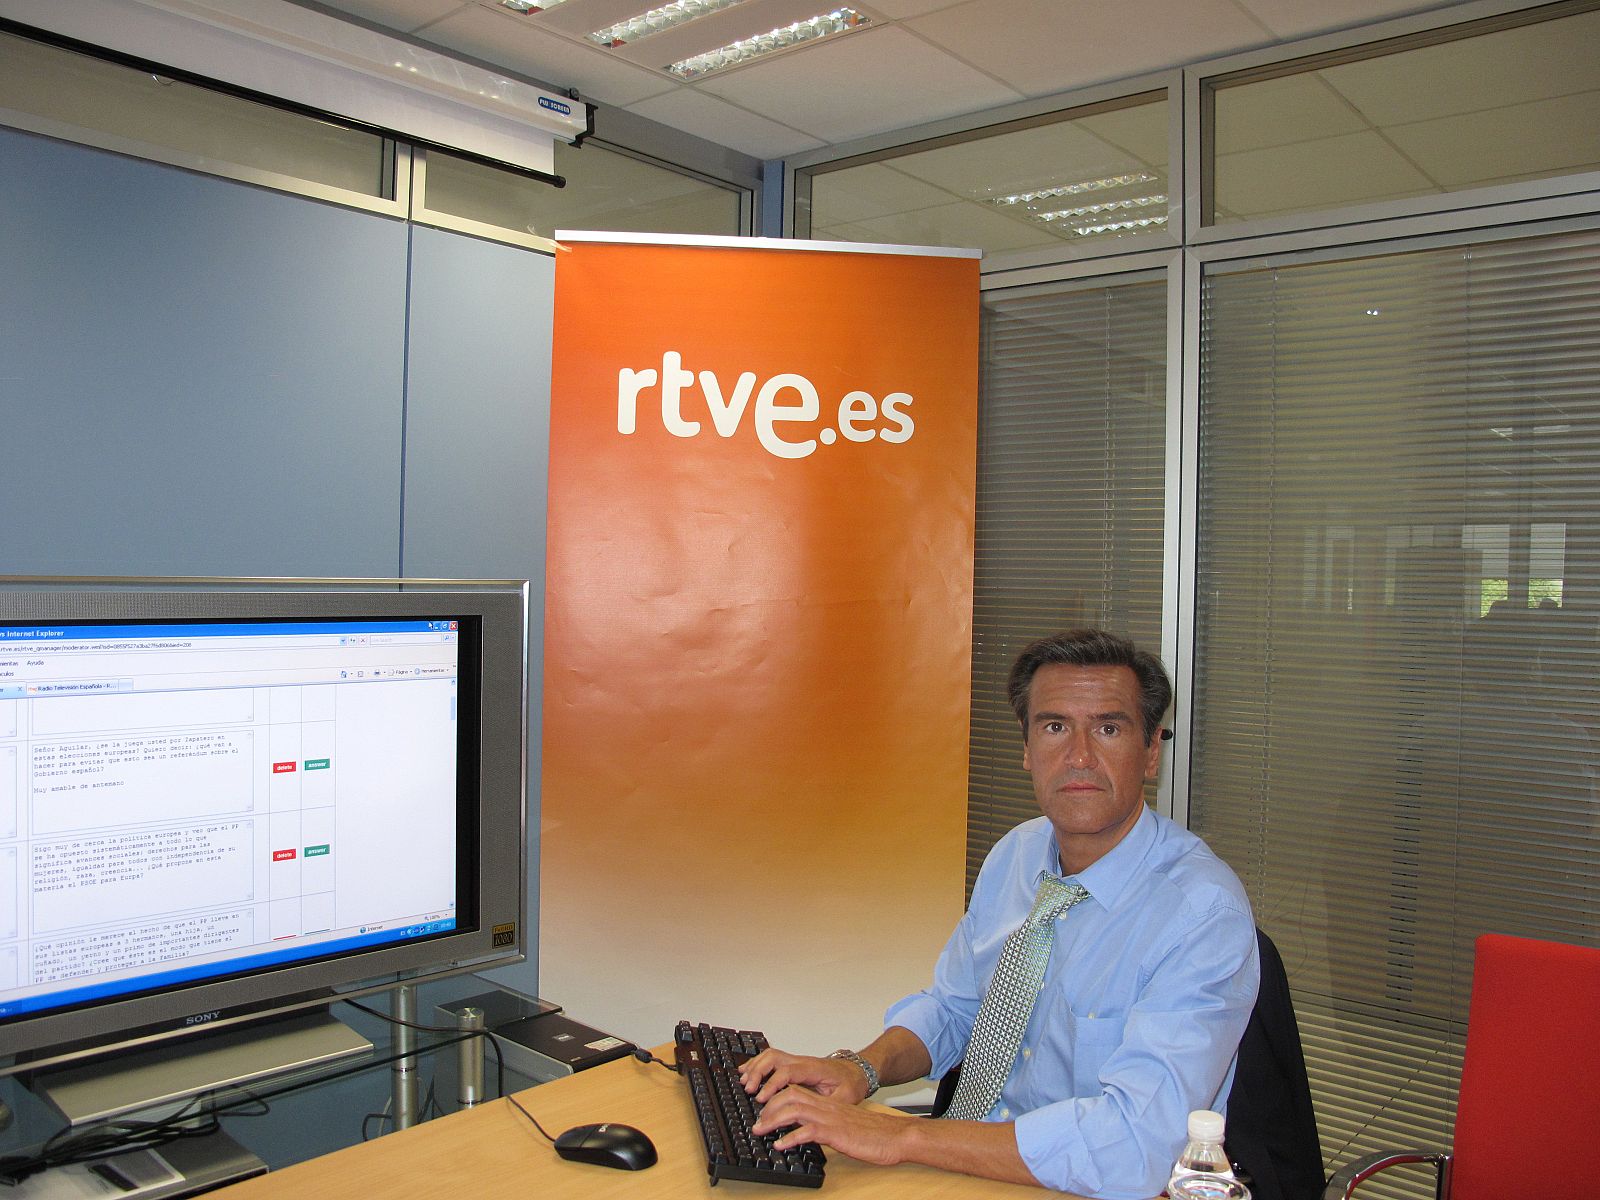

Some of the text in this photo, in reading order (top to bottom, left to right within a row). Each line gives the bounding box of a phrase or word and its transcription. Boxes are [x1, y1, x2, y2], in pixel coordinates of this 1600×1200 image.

[617, 351, 915, 459] rtve.es
[36, 630, 64, 638] Explorer
[186, 1011, 220, 1024] SONY
